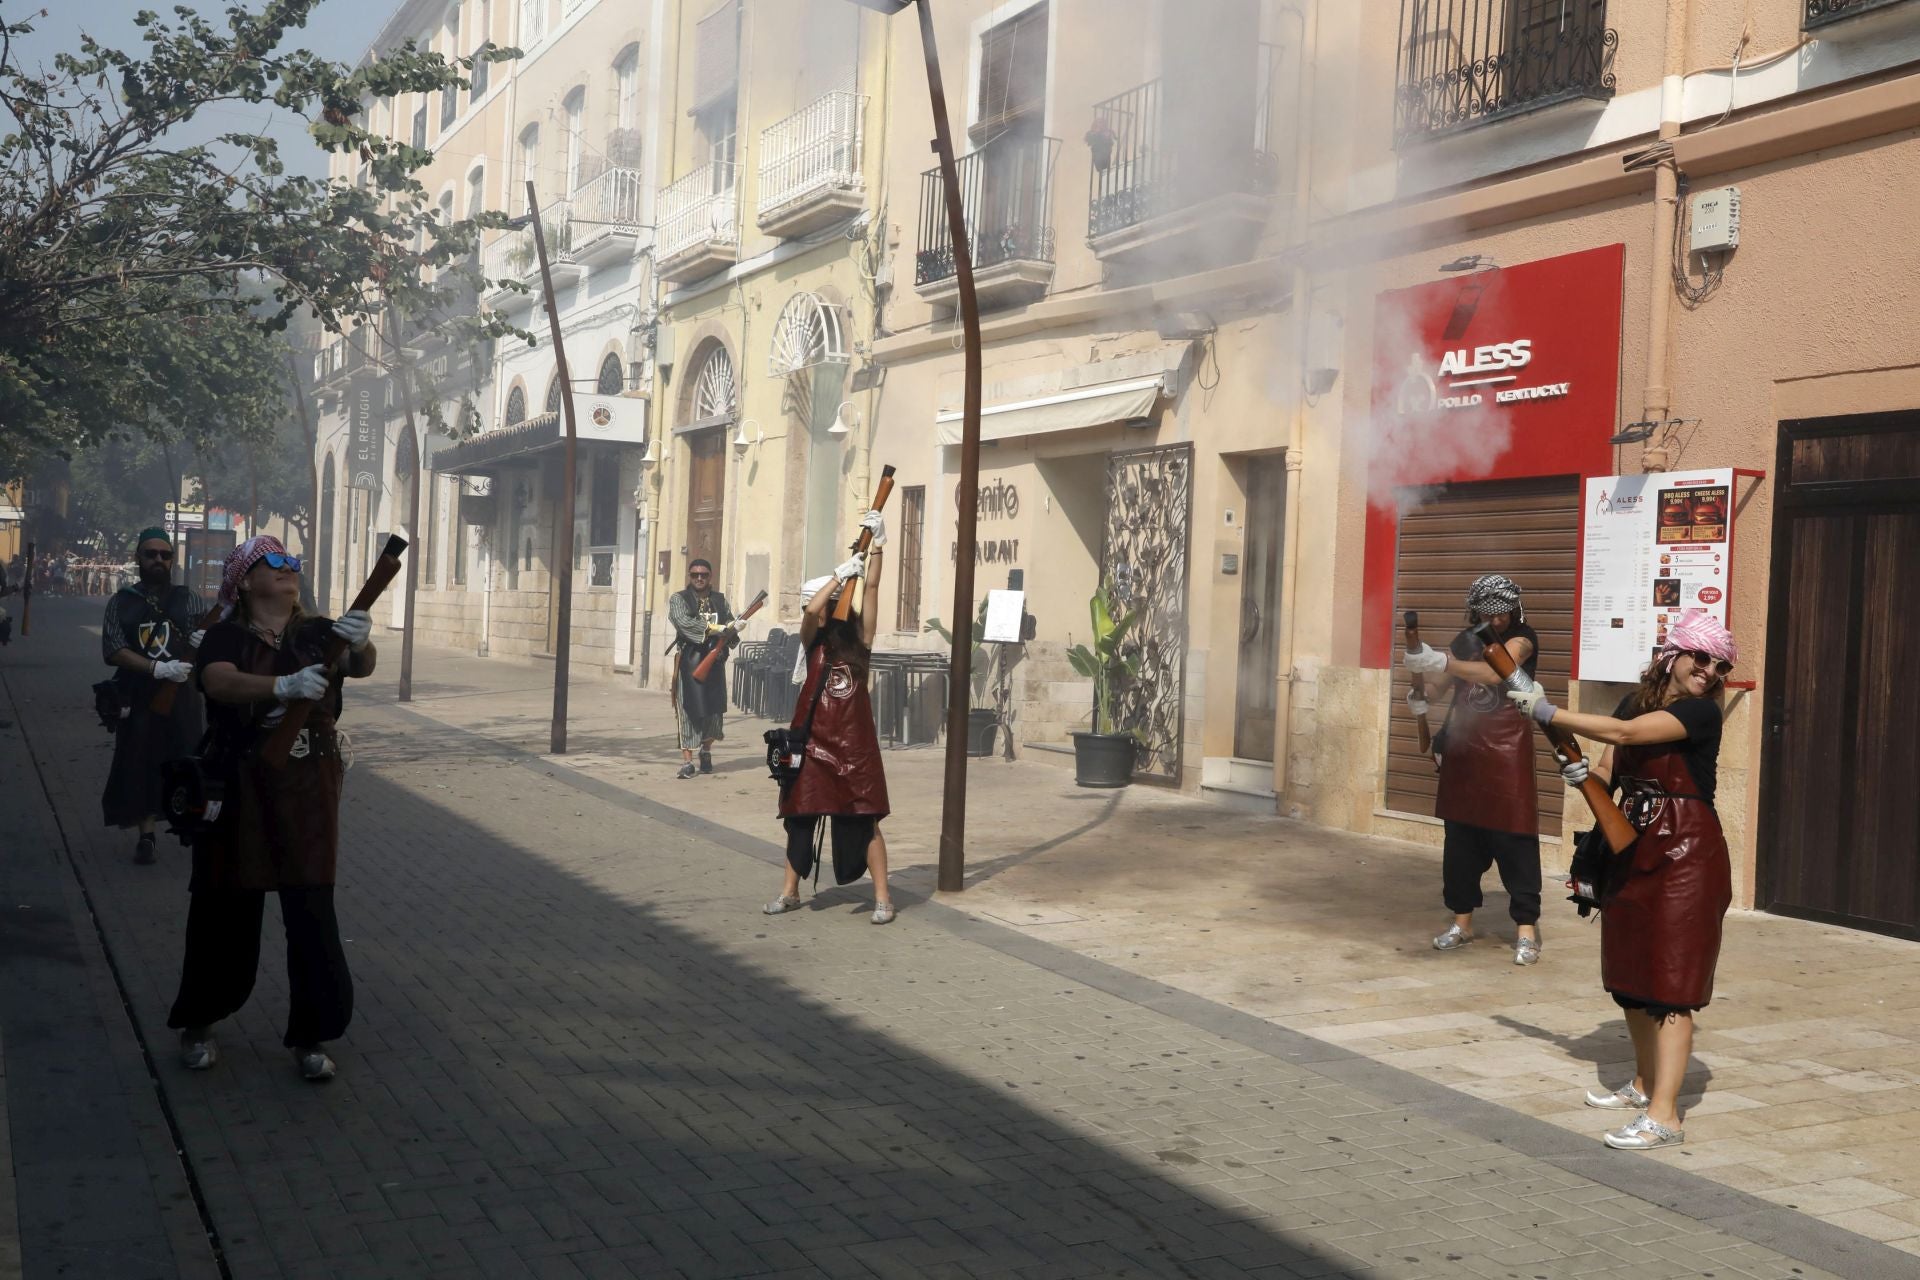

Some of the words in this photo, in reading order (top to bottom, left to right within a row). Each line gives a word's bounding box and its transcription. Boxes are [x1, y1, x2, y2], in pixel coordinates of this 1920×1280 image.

[1438, 339, 1531, 376] ALESS
[1438, 394, 1482, 409] POLLO
[1496, 382, 1571, 403] KENTUCKY
[359, 390, 370, 442] REFUGIO
[358, 446, 369, 460] EL
[1616, 495, 1644, 504] ALESS
